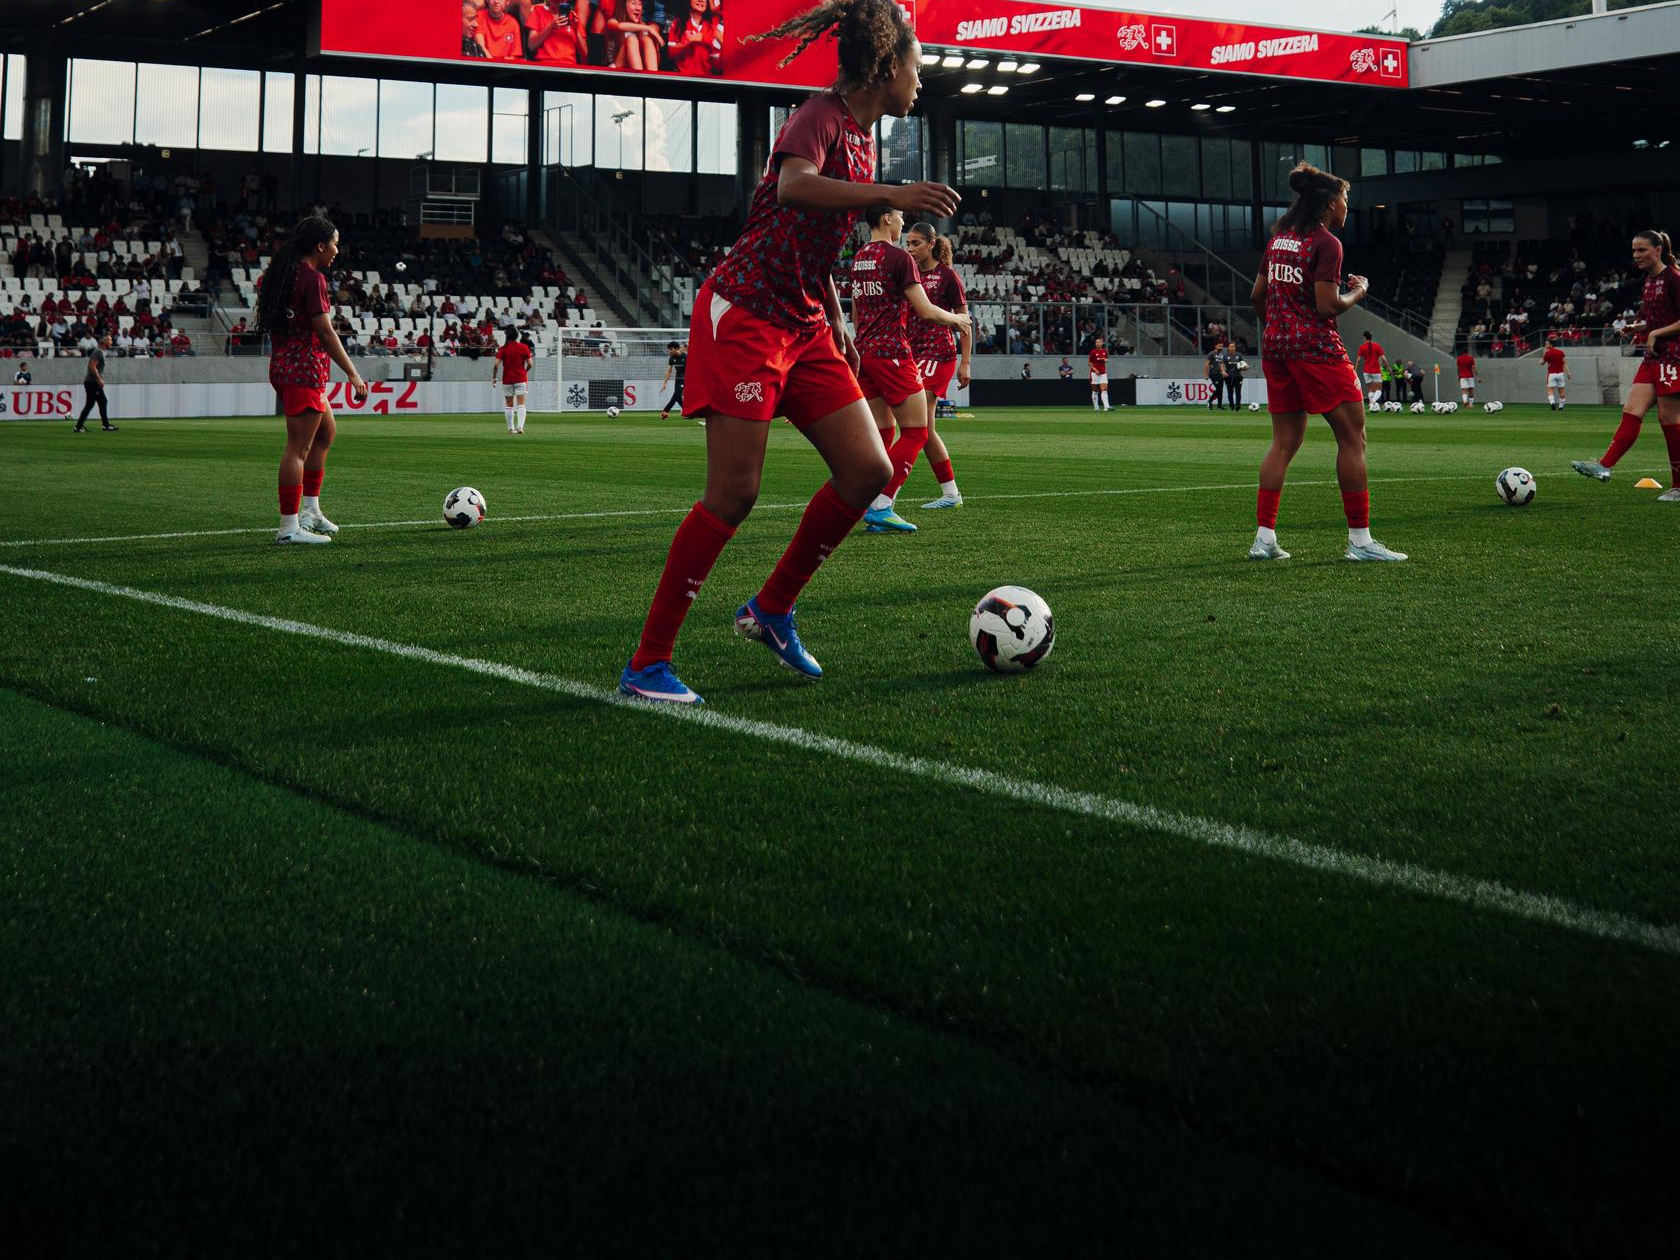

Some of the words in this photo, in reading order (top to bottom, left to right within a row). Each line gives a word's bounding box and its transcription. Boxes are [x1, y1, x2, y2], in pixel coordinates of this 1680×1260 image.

[956, 17, 1008, 41] SIAMO
[1010, 8, 1081, 34] SVIZZERA
[1210, 41, 1256, 65] SIAMO
[1257, 33, 1319, 59] SVIZZERA
[853, 260, 877, 271] SUISSE
[1274, 263, 1304, 285] UBS
[863, 281, 883, 296] UBS
[1659, 363, 1678, 382] 14
[11, 390, 73, 415] UBS
